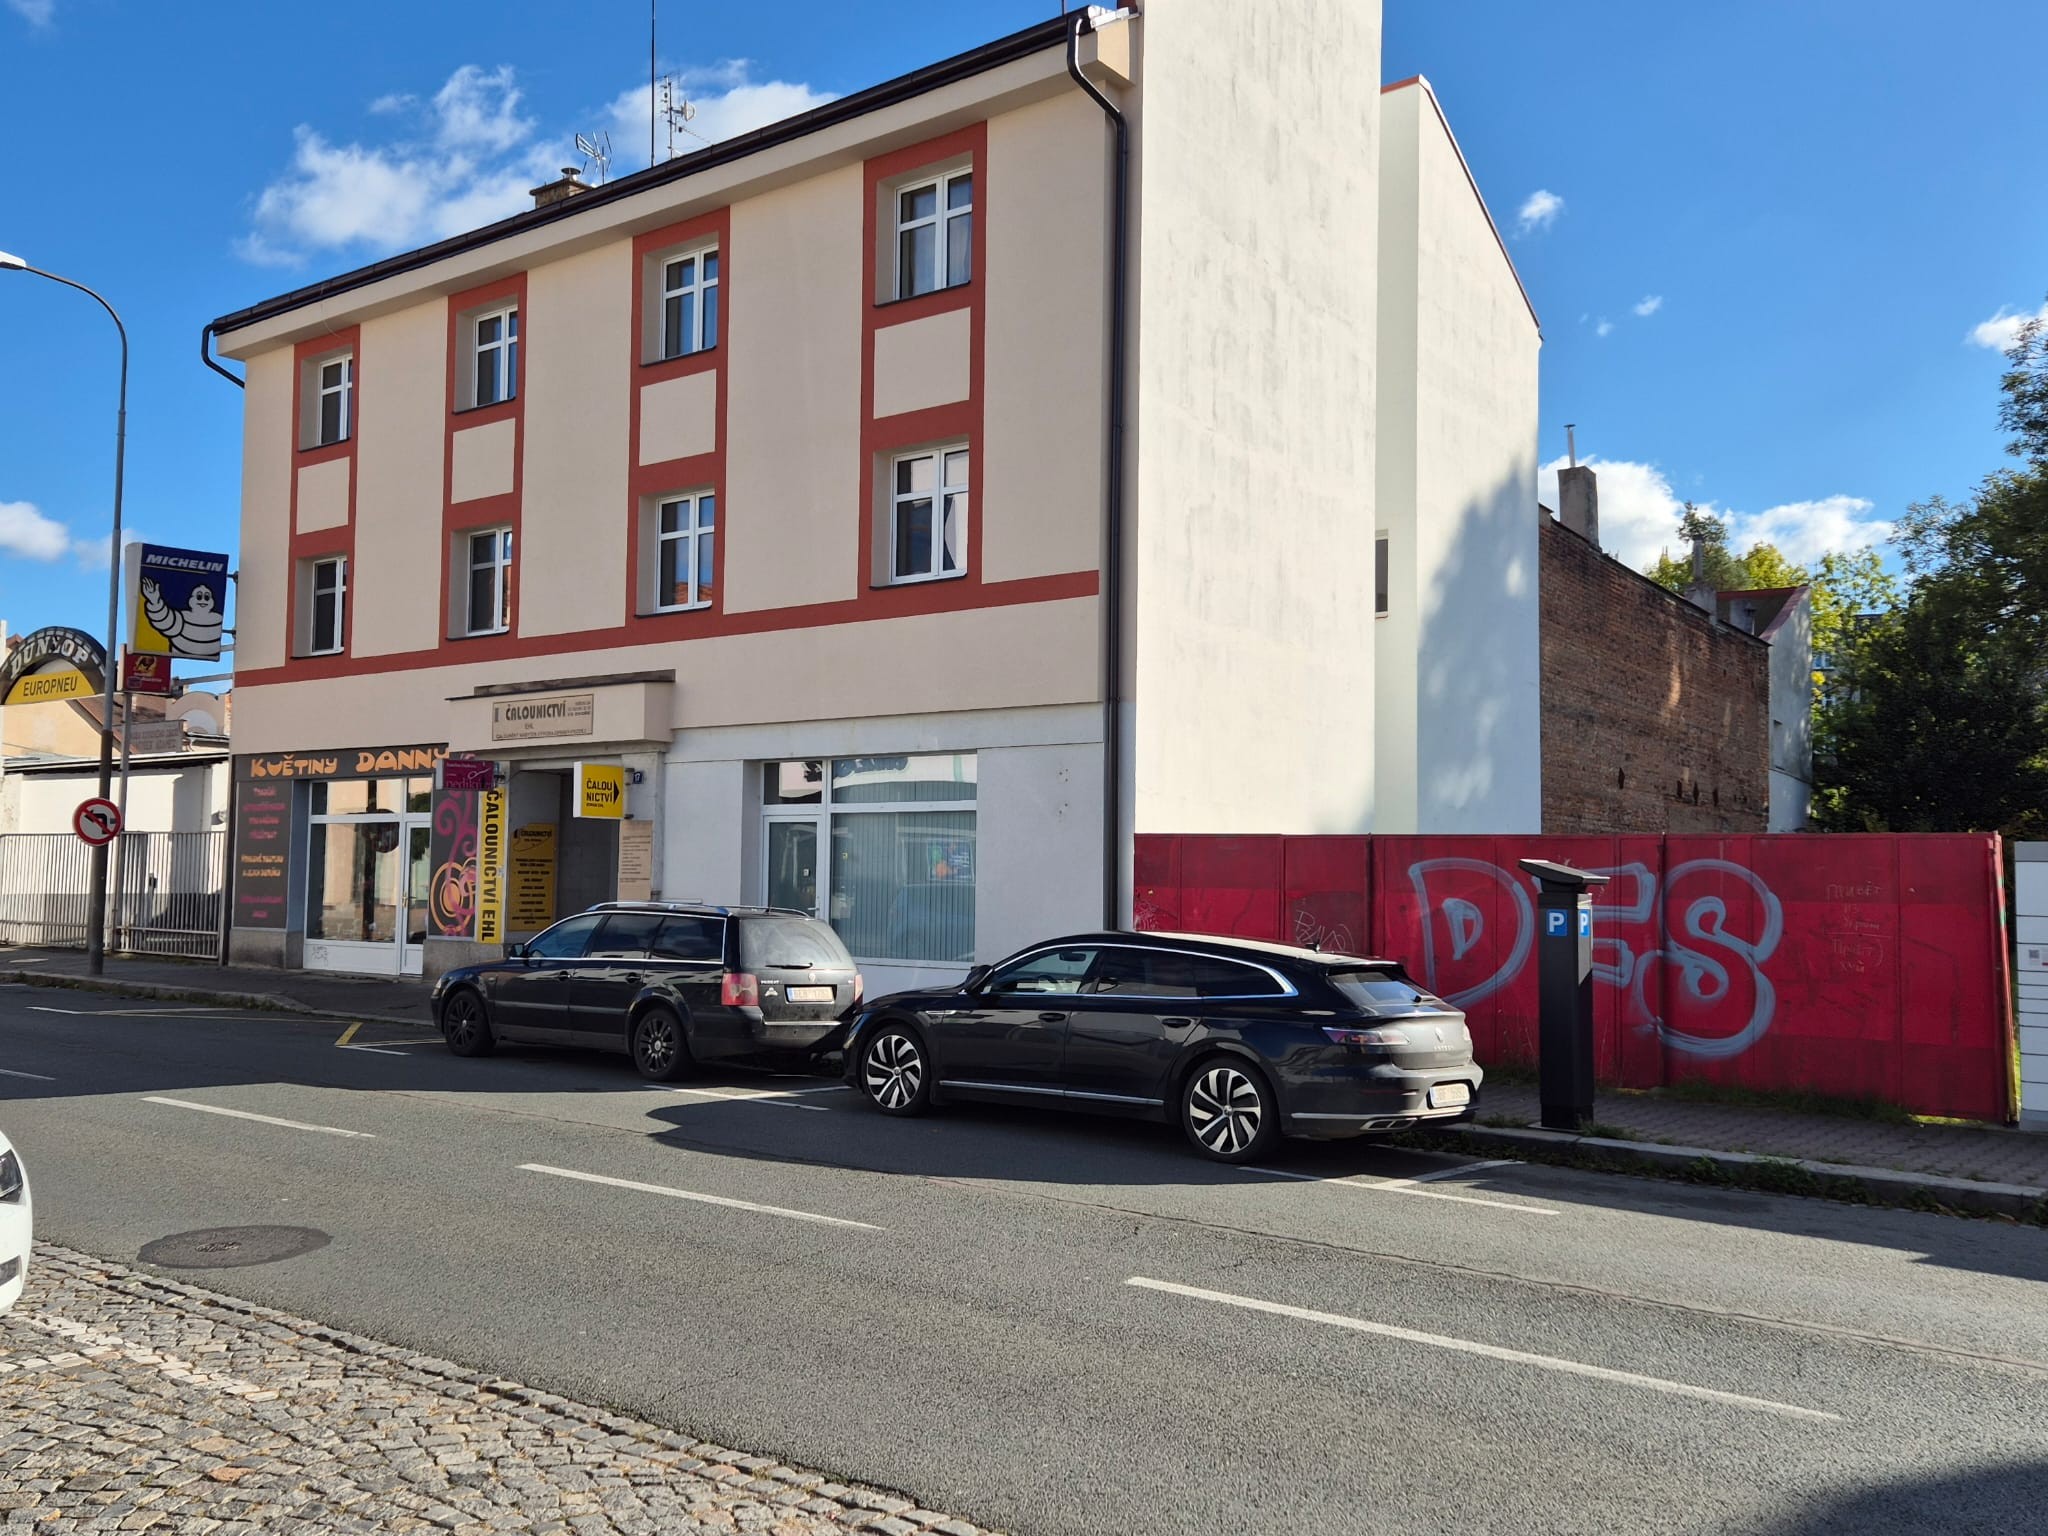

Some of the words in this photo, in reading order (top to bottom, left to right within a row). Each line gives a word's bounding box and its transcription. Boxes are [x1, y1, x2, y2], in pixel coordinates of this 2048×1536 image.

[145, 553, 224, 572] MICHELIN
[10, 635, 89, 679] DUNLOP
[23, 676, 78, 697] EUROPNEU
[505, 700, 567, 721] ČALOUNICTVÍ
[250, 754, 338, 778] KVĚTINY
[355, 747, 451, 773] DANNY
[586, 778, 613, 791] ČALOU
[586, 791, 613, 803] NICTVÍ
[483, 790, 504, 904] ČALOUNICTVÍ
[481, 909, 496, 941] EHL
[1548, 912, 1565, 933] P
[1580, 912, 1588, 933] P
